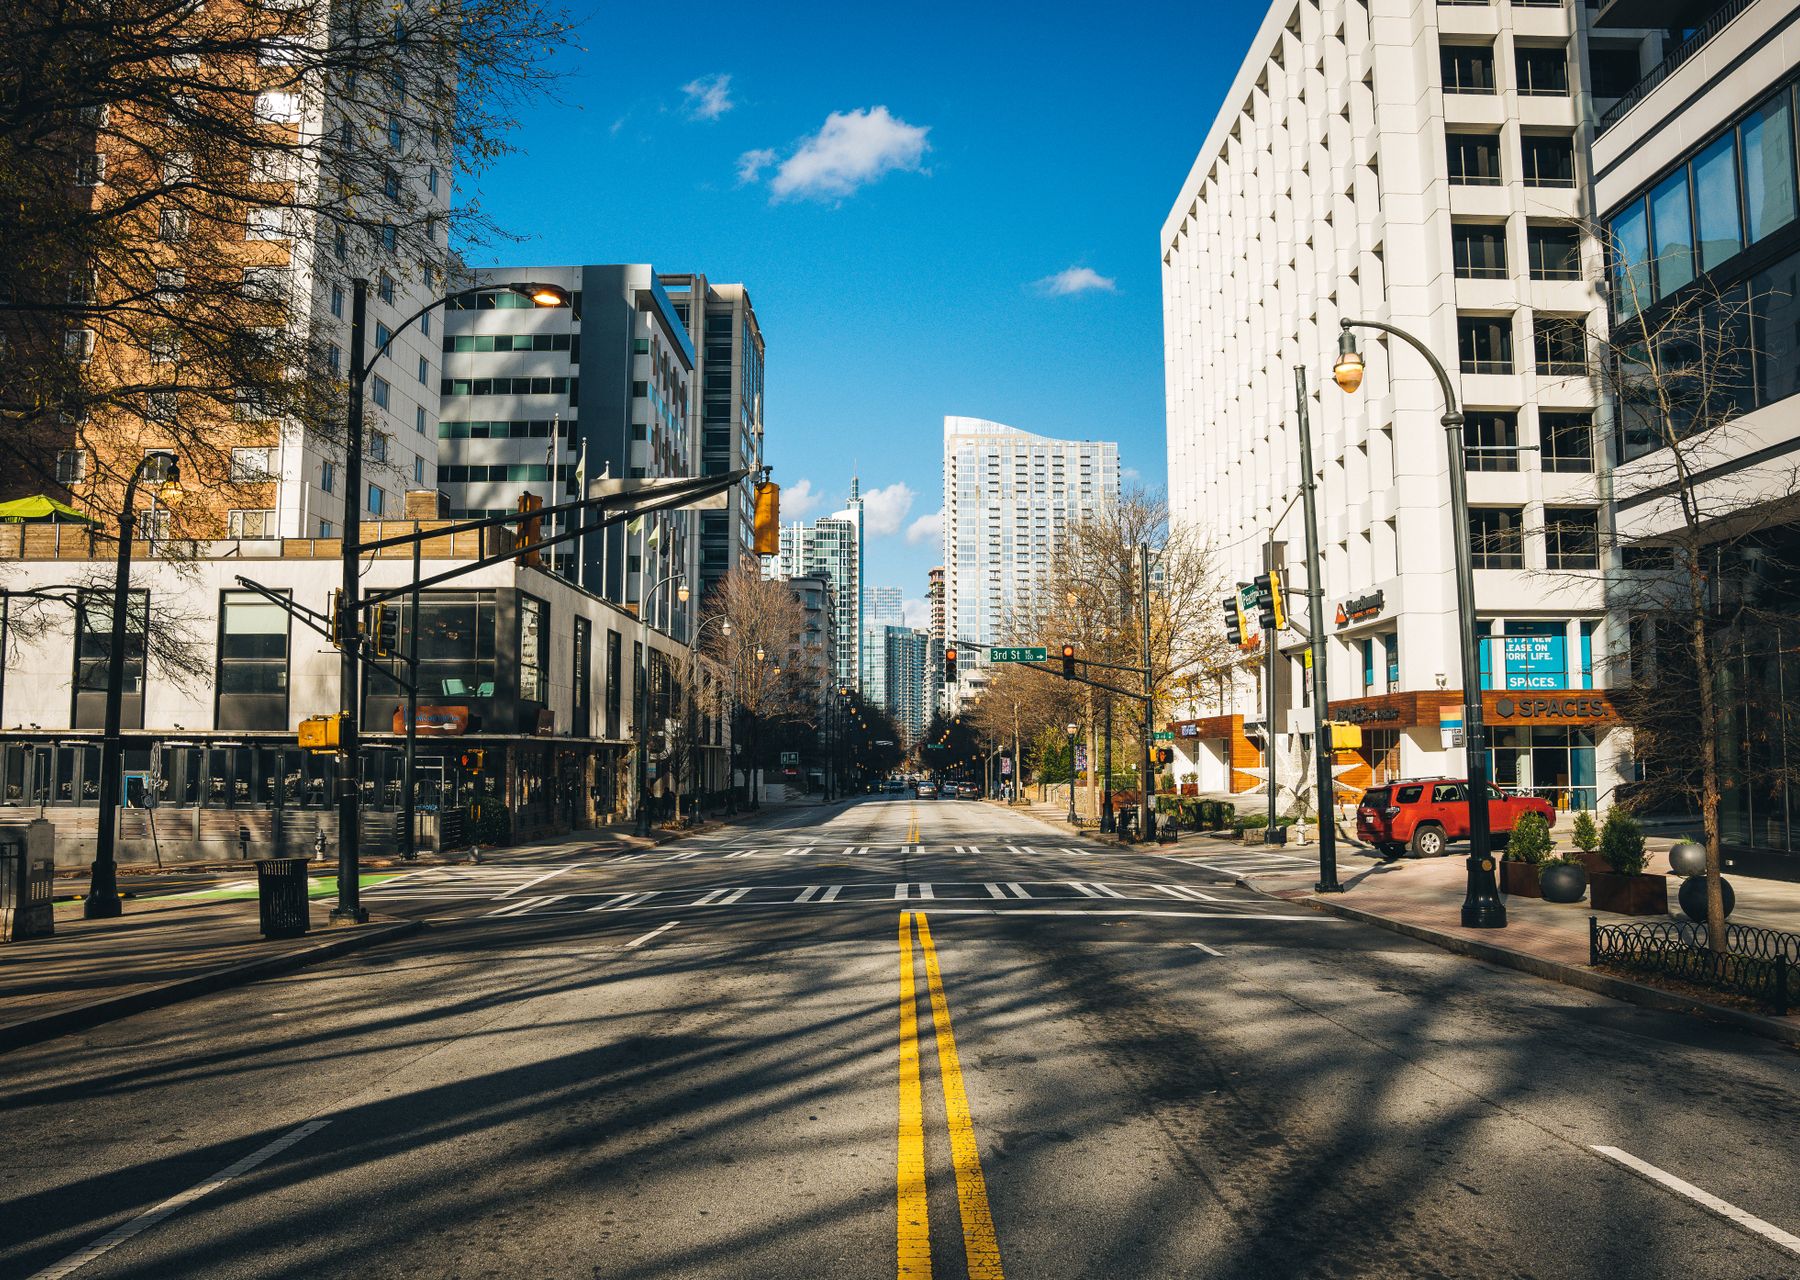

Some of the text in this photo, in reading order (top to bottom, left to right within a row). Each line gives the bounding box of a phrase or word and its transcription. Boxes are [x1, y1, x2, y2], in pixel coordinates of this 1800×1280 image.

[1534, 643, 1548, 652] ON
[992, 650, 1021, 660] 3rd St
[1530, 652, 1553, 660] LIFE.
[1509, 677, 1557, 687] SPACES.
[1519, 698, 1609, 718] SPACES.
